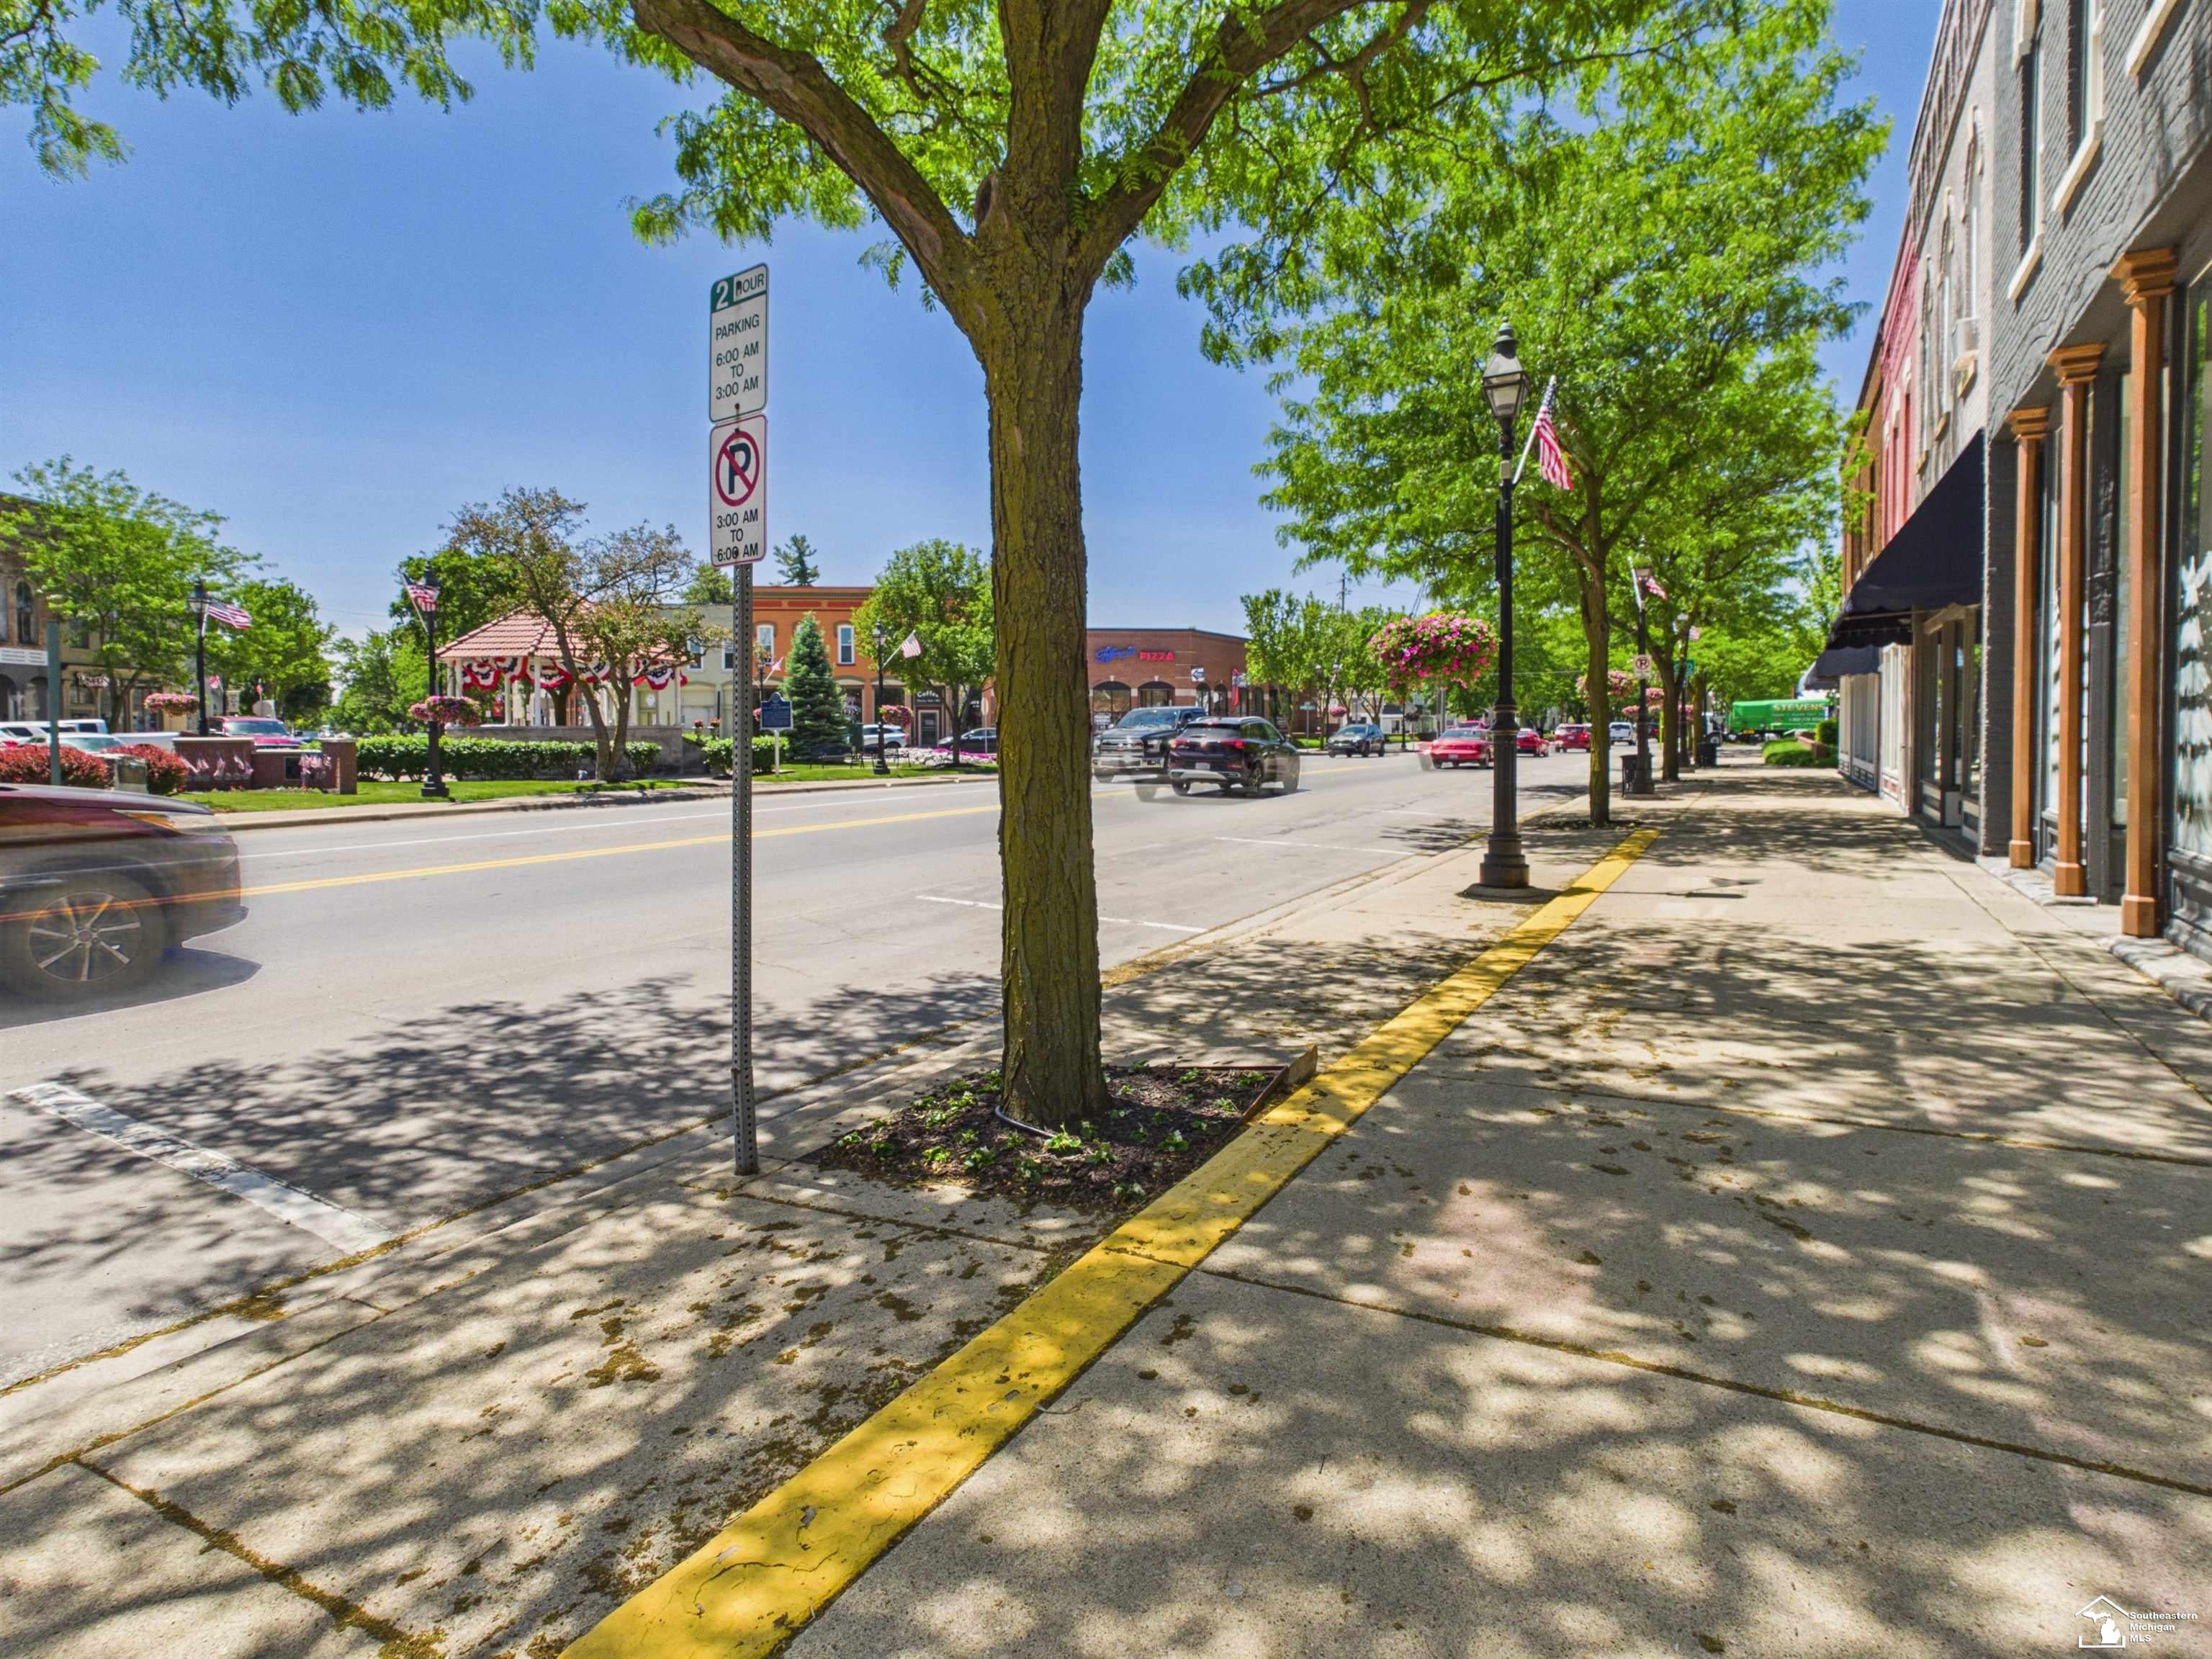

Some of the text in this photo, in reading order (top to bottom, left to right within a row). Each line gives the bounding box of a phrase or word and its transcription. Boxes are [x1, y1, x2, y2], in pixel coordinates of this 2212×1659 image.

[716, 274, 765, 310] 2 HOUR
[716, 314, 759, 341] PARKING
[716, 341, 758, 367] 6:00 AM
[730, 363, 744, 378] TO
[716, 376, 758, 400] 3:00 AM
[716, 508, 758, 529] 3:00 AM
[730, 529, 743, 542] TO
[717, 542, 758, 562] 6:00 AM
[1140, 651, 1175, 662] PIZZA
[1773, 703, 1825, 711] STEVENS
